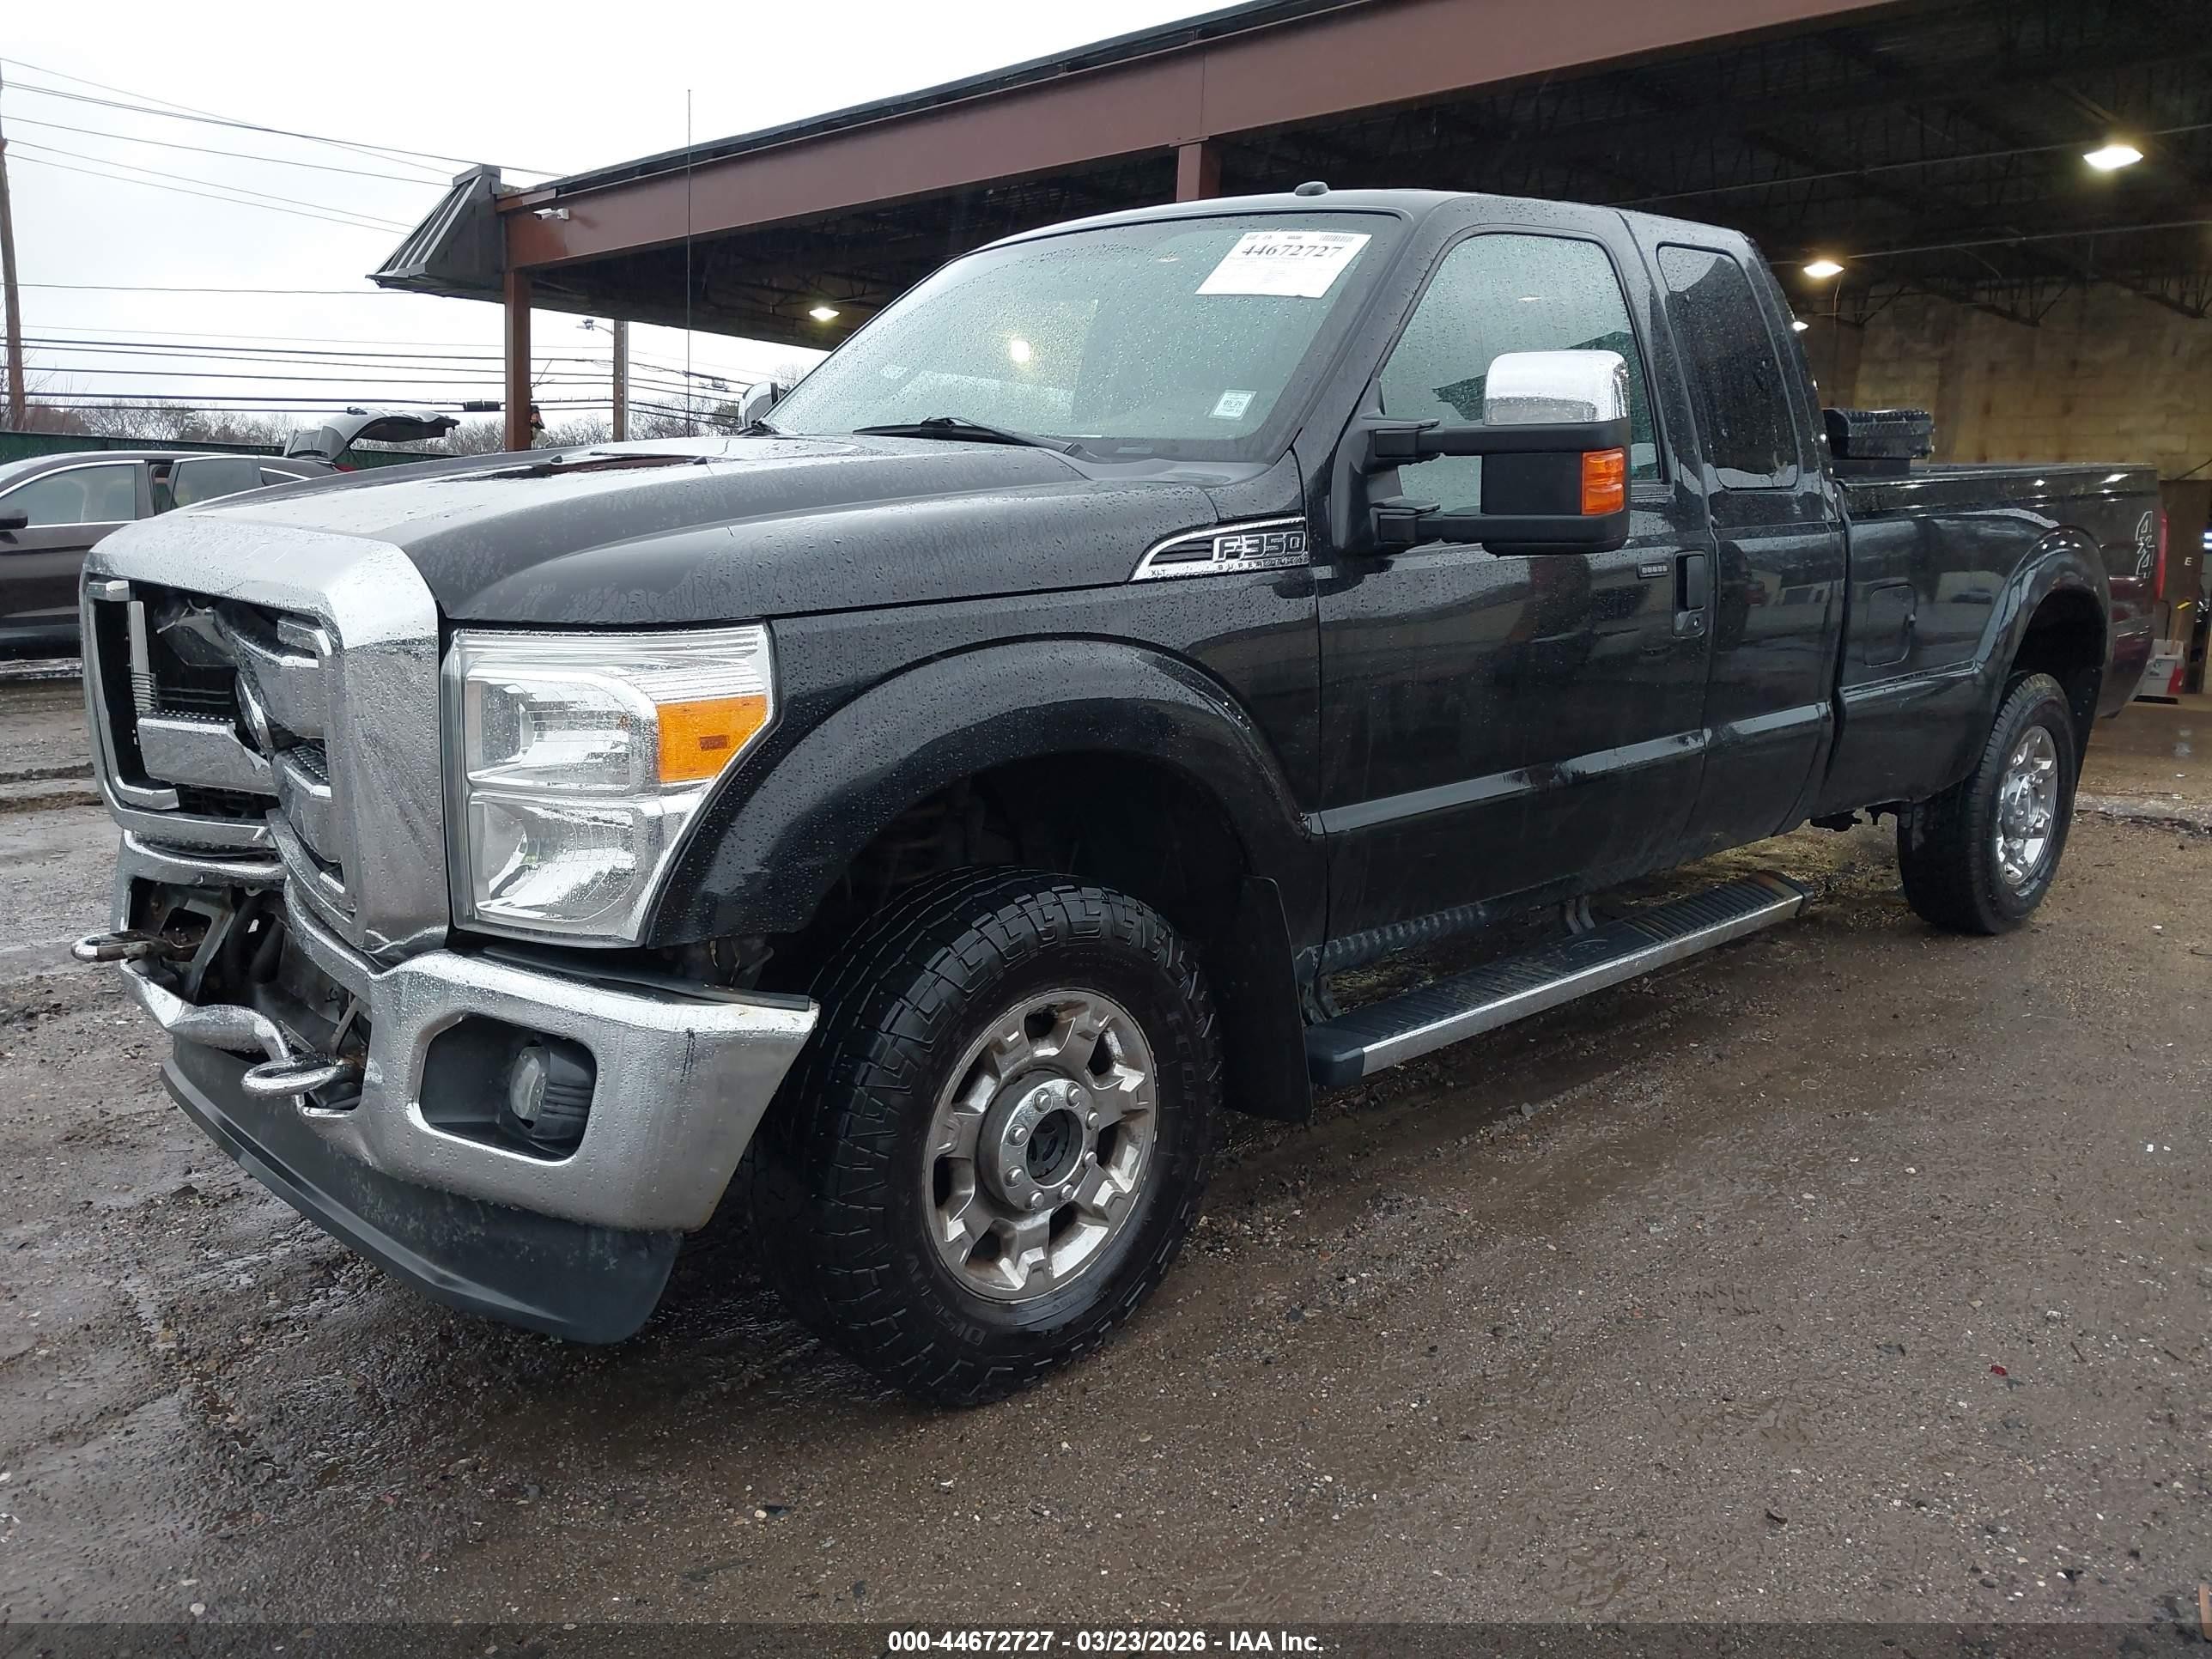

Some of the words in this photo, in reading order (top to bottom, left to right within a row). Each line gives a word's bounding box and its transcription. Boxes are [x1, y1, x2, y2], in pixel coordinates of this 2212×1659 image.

[1242, 244, 1345, 258] 44672727
[1218, 561, 1263, 571] SUPER
[2184, 556, 2192, 566] E
